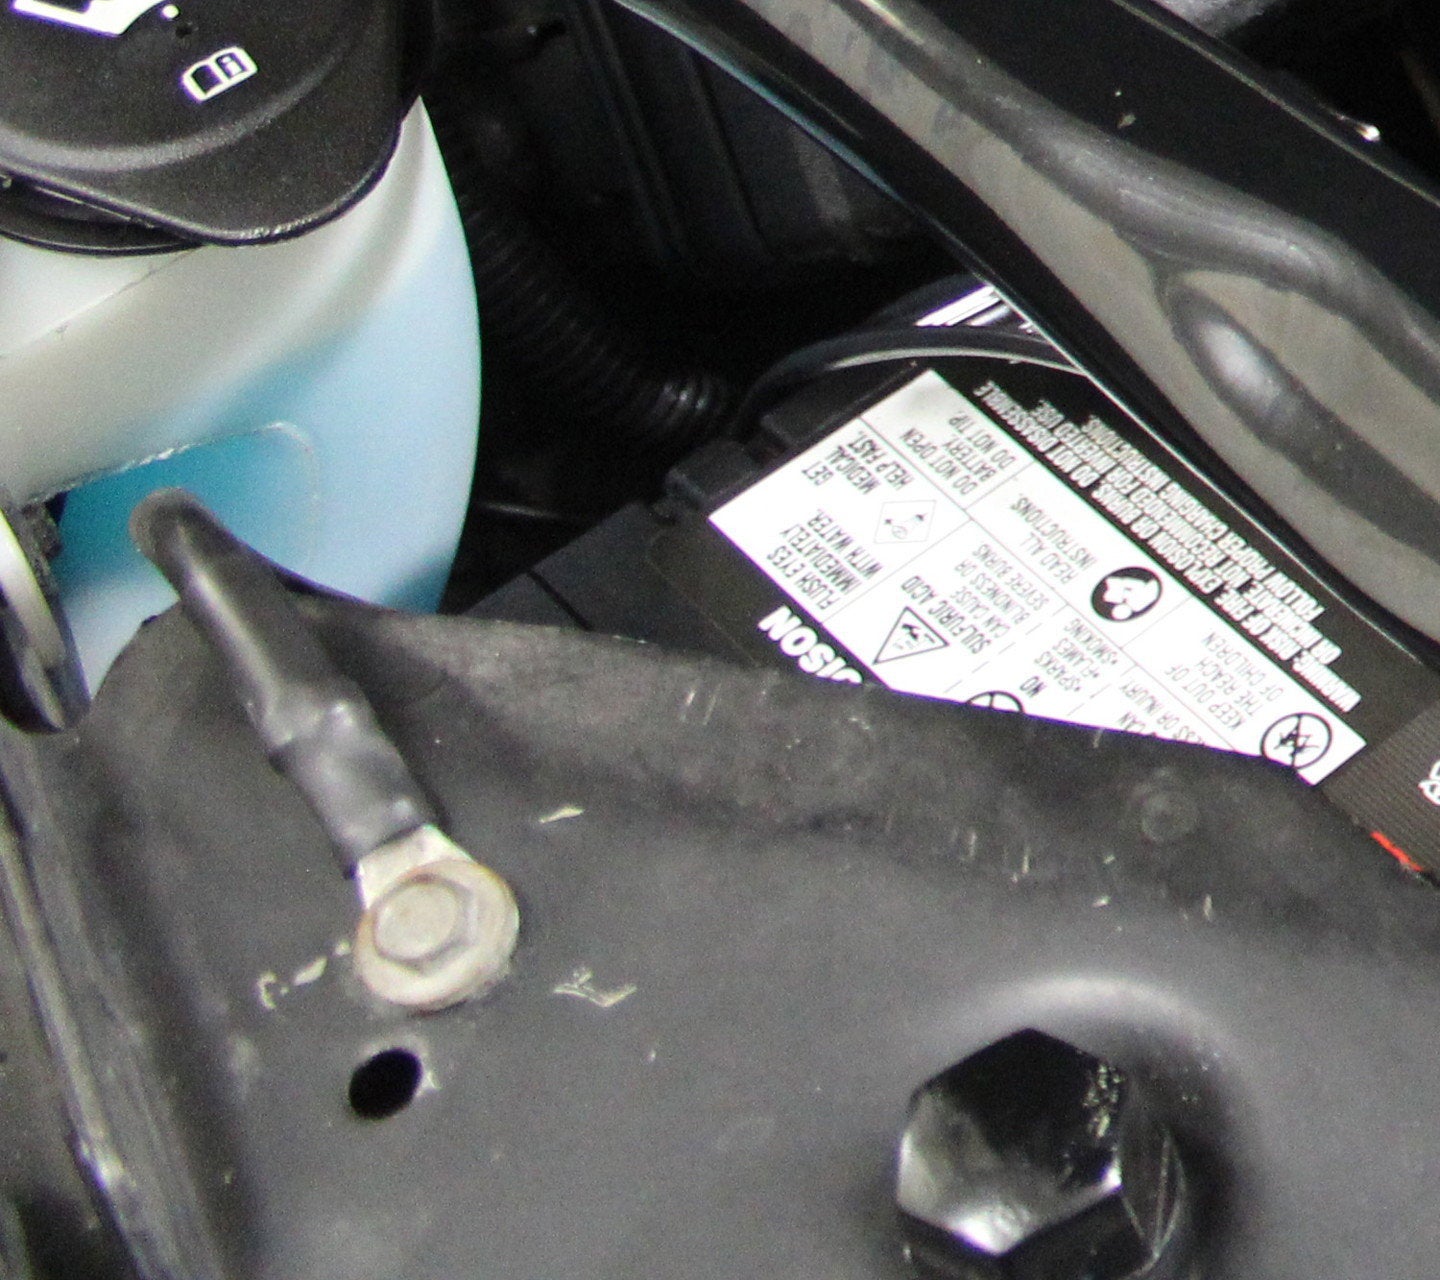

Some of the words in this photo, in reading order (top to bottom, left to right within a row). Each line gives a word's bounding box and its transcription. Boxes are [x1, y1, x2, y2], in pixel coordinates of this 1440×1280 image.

[970, 379, 1061, 453] DISASSEMBLE
[1025, 397, 1066, 429] USE.
[841, 429, 888, 466] FAST.
[897, 426, 939, 459] OPEN
[965, 427, 1000, 454] NOT
[1043, 442, 1084, 473] NOT
[1050, 420, 1118, 474] INVERTED
[1075, 412, 1172, 491] INSTRUCTIONS.
[800, 459, 836, 486] GET
[820, 444, 883, 495] MEDICAL
[872, 457, 916, 490] HELP
[926, 453, 961, 480] NOT
[988, 447, 1017, 469] DO
[1067, 462, 1101, 488] DO
[950, 473, 979, 495] DO
[1103, 464, 1142, 495] FOR
[1126, 485, 1228, 568] RECOMMENDED
[1127, 514, 1161, 540] OR
[1155, 480, 1230, 541] CHARGING
[800, 508, 857, 553] WATER.
[1004, 492, 1099, 570] INSTRUCTIONS.
[1015, 531, 1049, 556] ALL
[763, 544, 807, 578] EYES
[775, 521, 865, 594] IMMEDIATELY
[841, 545, 886, 579] WITH
[952, 558, 978, 577] OR
[1037, 550, 1080, 584] READ
[1145, 529, 1225, 594] EXPLOSION
[1213, 529, 1277, 581] PROPER
[791, 570, 842, 610] FLUSH
[897, 574, 938, 605] ACID
[1211, 558, 1252, 589] NOT
[948, 585, 991, 619] CAUSE
[966, 571, 1032, 625] BLINDNESS
[1002, 572, 1052, 611] SEVERE
[1260, 569, 1326, 622] FOLLOW
[924, 598, 994, 654] SULFURIC
[979, 613, 1012, 639] CAN
[1239, 610, 1274, 636] OF
[1255, 624, 1303, 661] RISK
[1307, 637, 1344, 665] OR
[1016, 674, 1049, 698] NO
[1163, 661, 1191, 682] OF
[1192, 655, 1242, 695] REACH
[1285, 649, 1365, 713] WARNING:
[1180, 676, 1217, 704] OUT
[1231, 689, 1266, 716] THE
[1257, 681, 1285, 702] OF
[1205, 697, 1248, 731] KEEP
